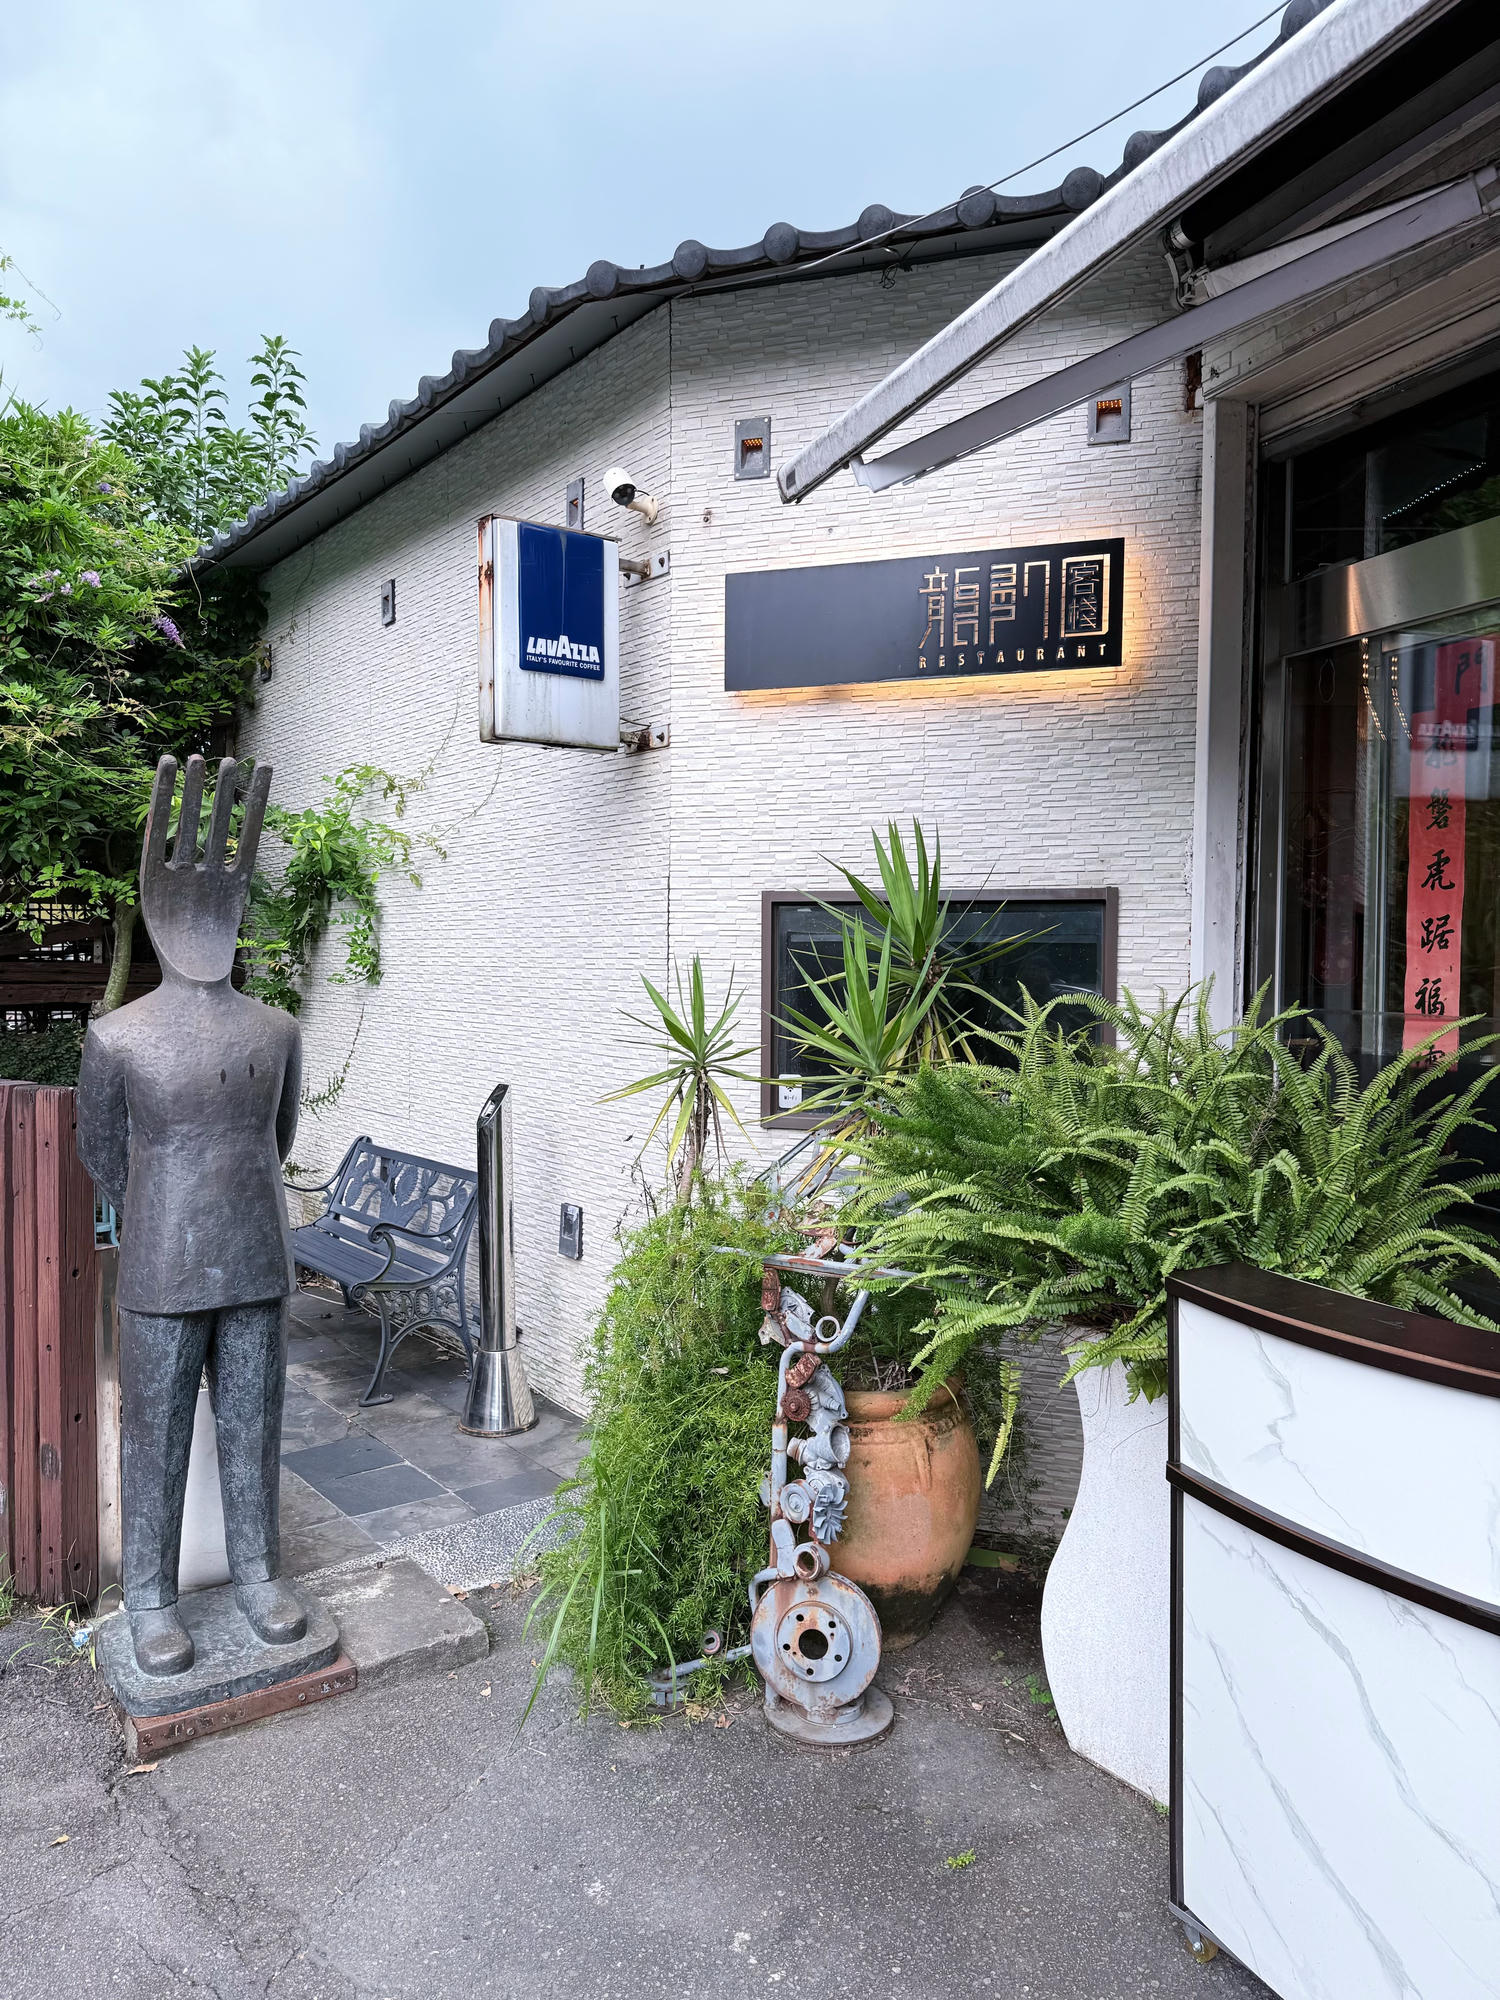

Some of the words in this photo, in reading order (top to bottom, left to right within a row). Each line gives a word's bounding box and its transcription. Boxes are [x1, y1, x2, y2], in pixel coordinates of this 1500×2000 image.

[527, 635, 600, 663] LAVAZZA
[918, 644, 1107, 669] RESTAURANT
[527, 655, 547, 663] ITALY'S
[549, 658, 578, 667] FAVOURITE
[580, 662, 600, 671] COFFEE
